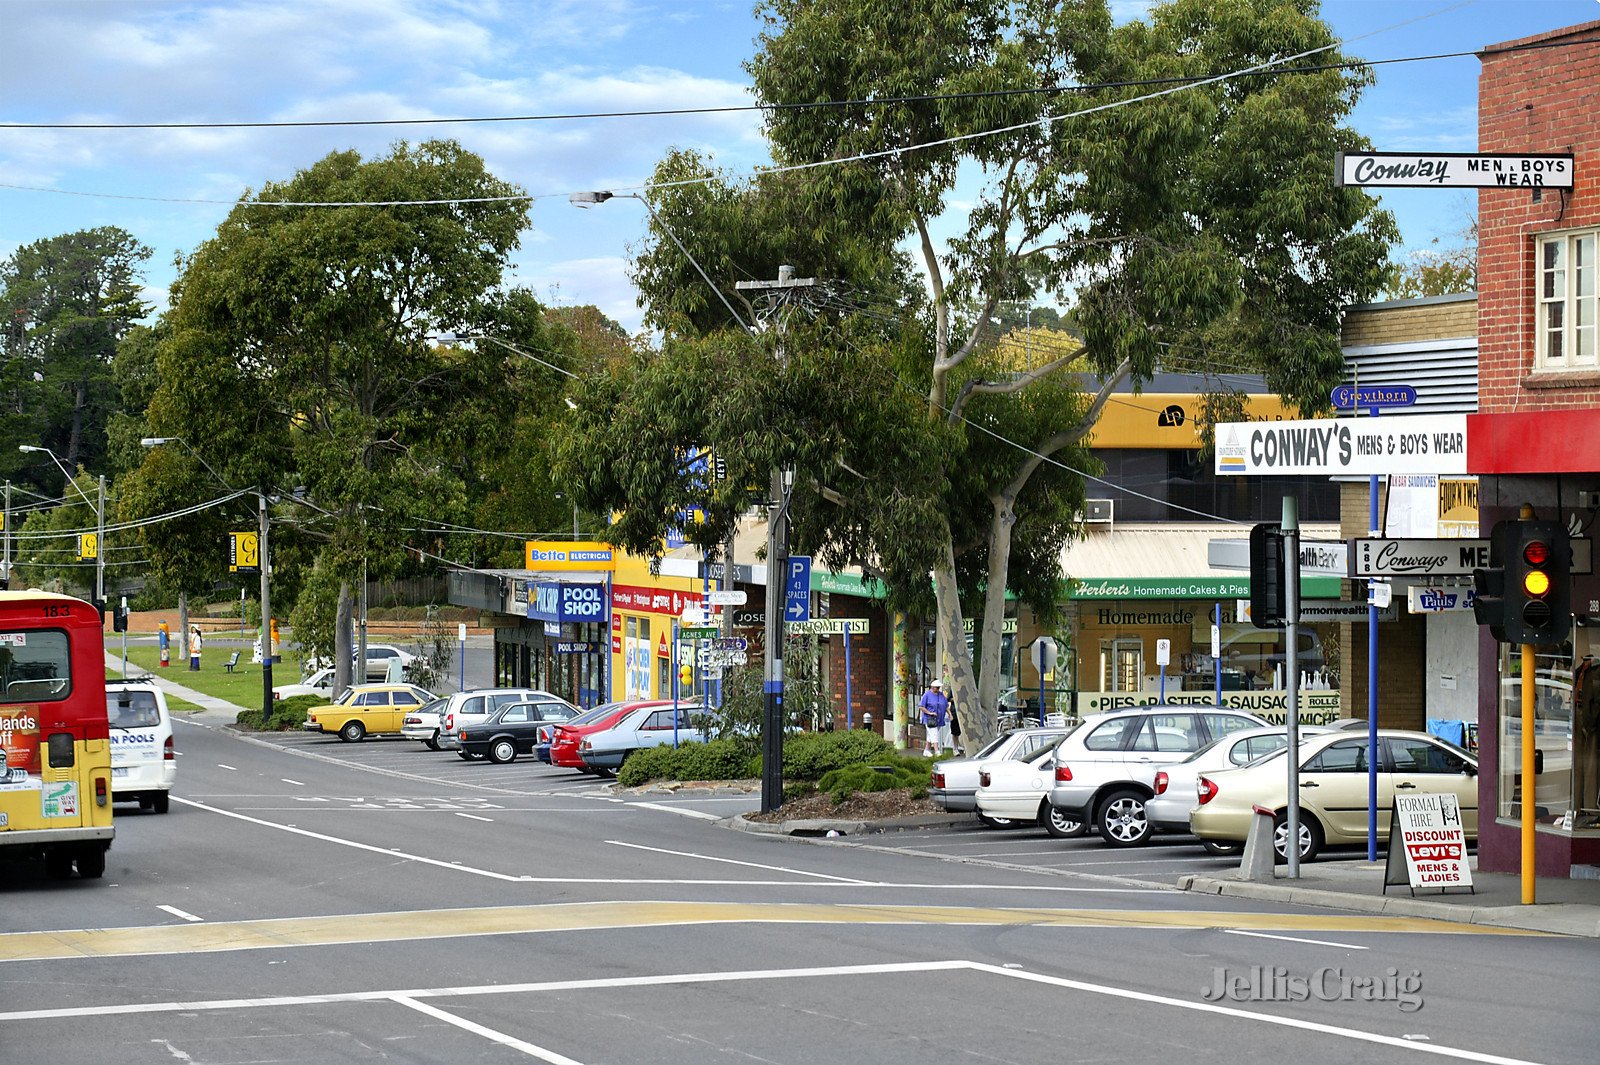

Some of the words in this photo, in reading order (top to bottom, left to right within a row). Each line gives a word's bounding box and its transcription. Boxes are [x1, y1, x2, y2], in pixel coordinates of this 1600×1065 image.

[1354, 157, 1450, 184] Conway
[1468, 159, 1502, 172] MEN
[1521, 160, 1565, 172] BOYS
[1496, 173, 1544, 186] WEAR
[1340, 389, 1407, 406] Greythorn
[1250, 422, 1352, 467] CONWAY'S
[1357, 435, 1383, 455] MENS
[1388, 434, 1396, 455] &
[1400, 433, 1428, 454] BOYS
[1433, 432, 1463, 454] WEAR
[531, 549, 566, 561] Betta
[570, 552, 610, 560] ELECTRICAL
[1375, 541, 1448, 573] Conways
[792, 562, 804, 578] P
[794, 581, 802, 590] 43
[1074, 582, 1131, 598] Herberts
[1133, 585, 1187, 595] Homemade
[1189, 585, 1216, 595] Cakes
[1219, 585, 1227, 594] &
[1229, 585, 1248, 595] Pies
[563, 587, 601, 601] POOL
[787, 590, 807, 599] SPACES
[564, 601, 602, 615] SHOP
[1424, 596, 1454, 607] Pauls
[42, 604, 71, 618] 183
[1098, 608, 1194, 625] Homemade
[682, 631, 702, 639] AGNES
[706, 631, 717, 639] AVE
[558, 643, 572, 652] POOL
[573, 643, 588, 652] SHOP
[1100, 697, 1135, 710] PIES
[122, 734, 155, 744] POOLS
[1399, 797, 1439, 812] FORMAL
[1409, 813, 1434, 827] HIRE
[1405, 830, 1461, 842] DISCOUNT
[1417, 863, 1448, 872] MENS
[1452, 863, 1459, 871] &
[1421, 873, 1460, 883] LADIES
